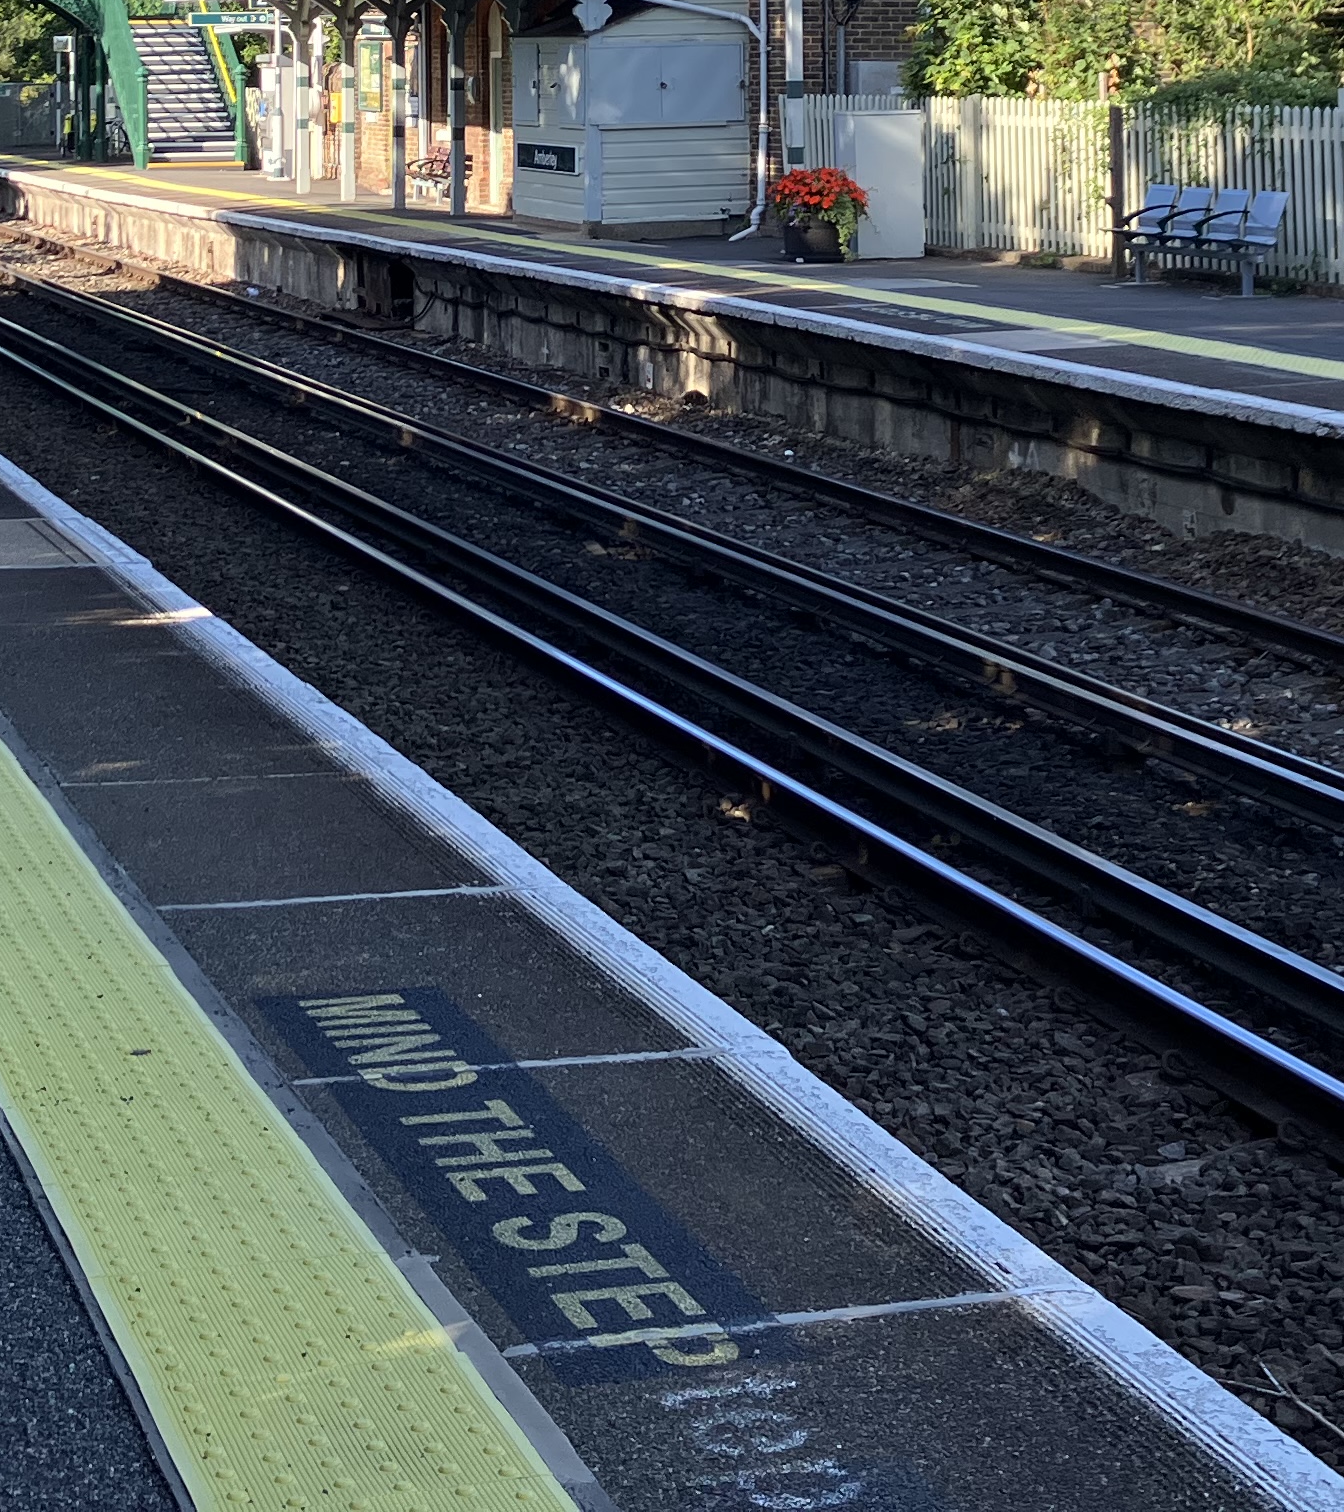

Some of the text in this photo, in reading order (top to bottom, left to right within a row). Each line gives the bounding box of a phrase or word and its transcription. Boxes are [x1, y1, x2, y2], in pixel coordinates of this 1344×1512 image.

[221, 15, 236, 24] Way
[534, 148, 558, 170] Amberley
[299, 993, 740, 1366] MIND THE STEP
